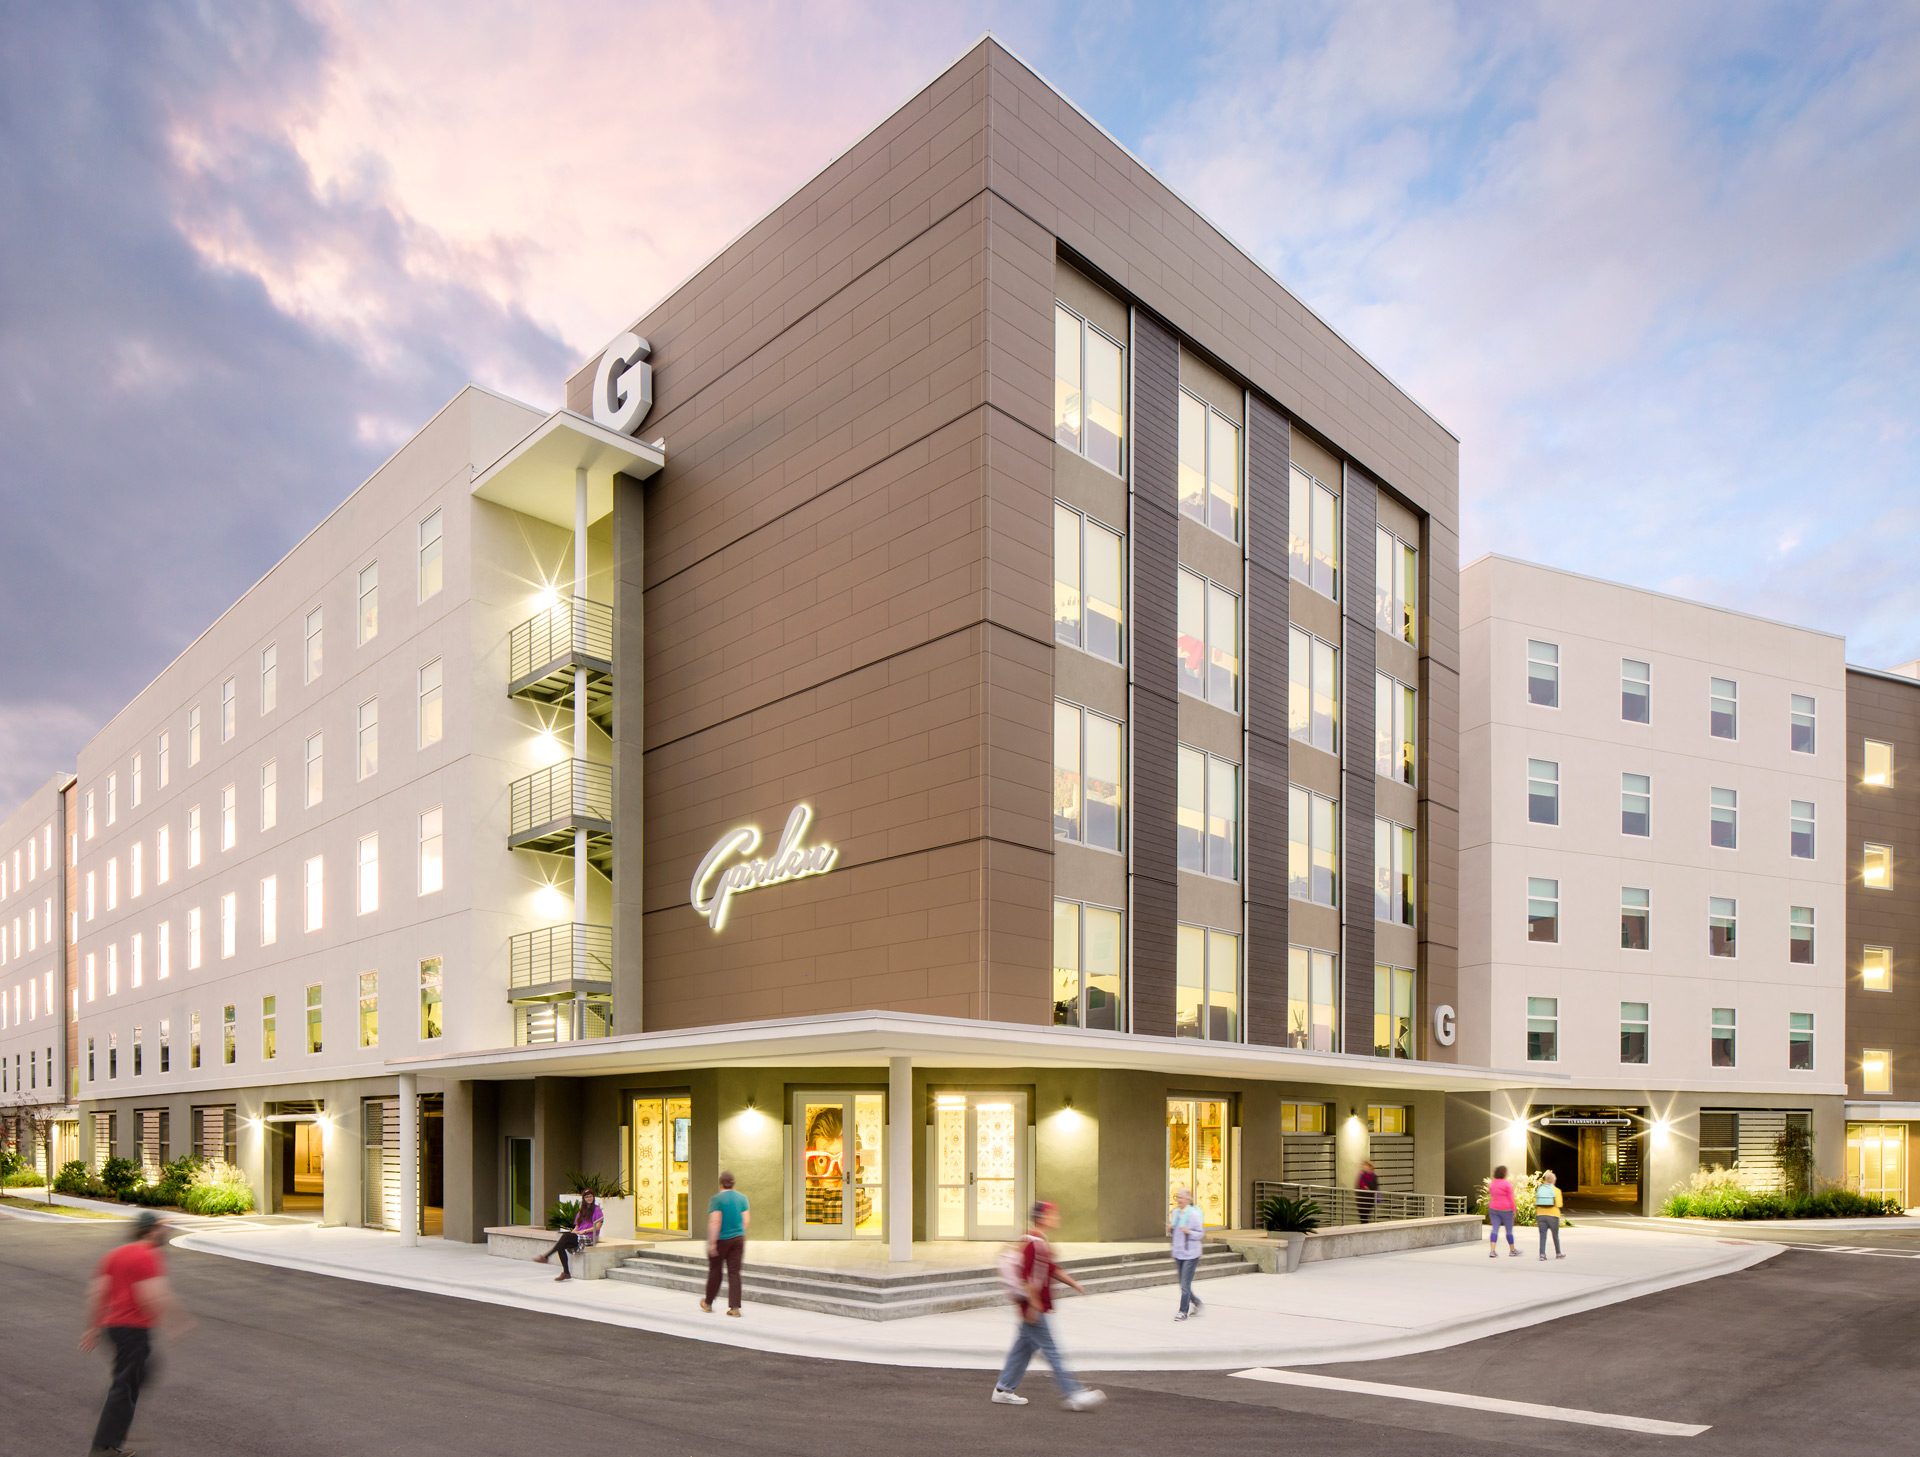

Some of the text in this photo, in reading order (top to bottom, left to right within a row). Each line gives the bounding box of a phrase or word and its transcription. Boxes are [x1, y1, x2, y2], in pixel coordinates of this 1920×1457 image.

[592, 332, 652, 436] G
[690, 806, 836, 929] Garden
[1434, 1004, 1456, 1046] G
